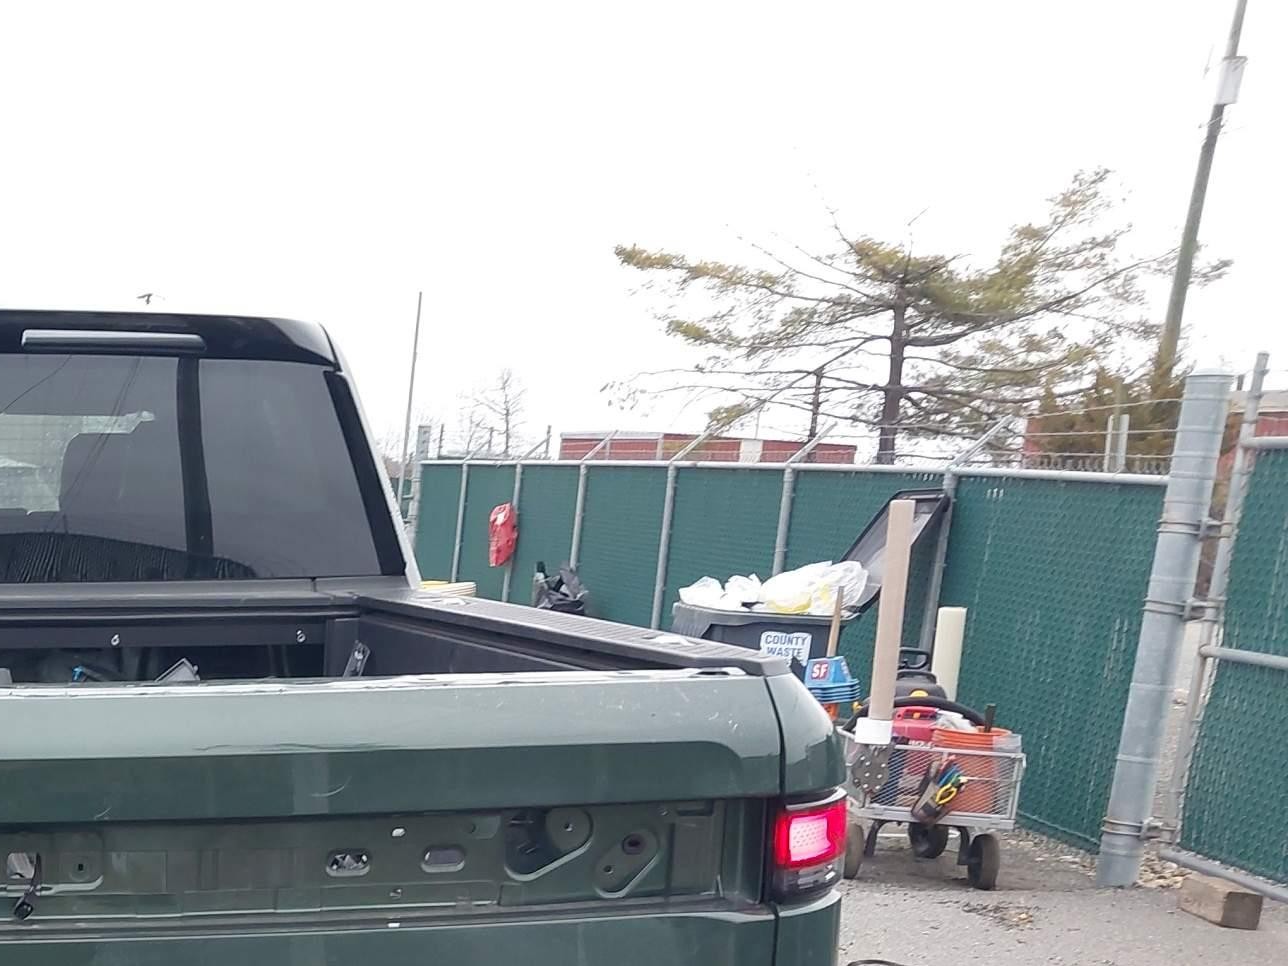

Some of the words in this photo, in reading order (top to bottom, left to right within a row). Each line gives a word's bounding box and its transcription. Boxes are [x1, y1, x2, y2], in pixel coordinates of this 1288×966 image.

[765, 634, 808, 646] COUNTY
[766, 647, 803, 658] WASTE
[811, 663, 829, 679] SF
